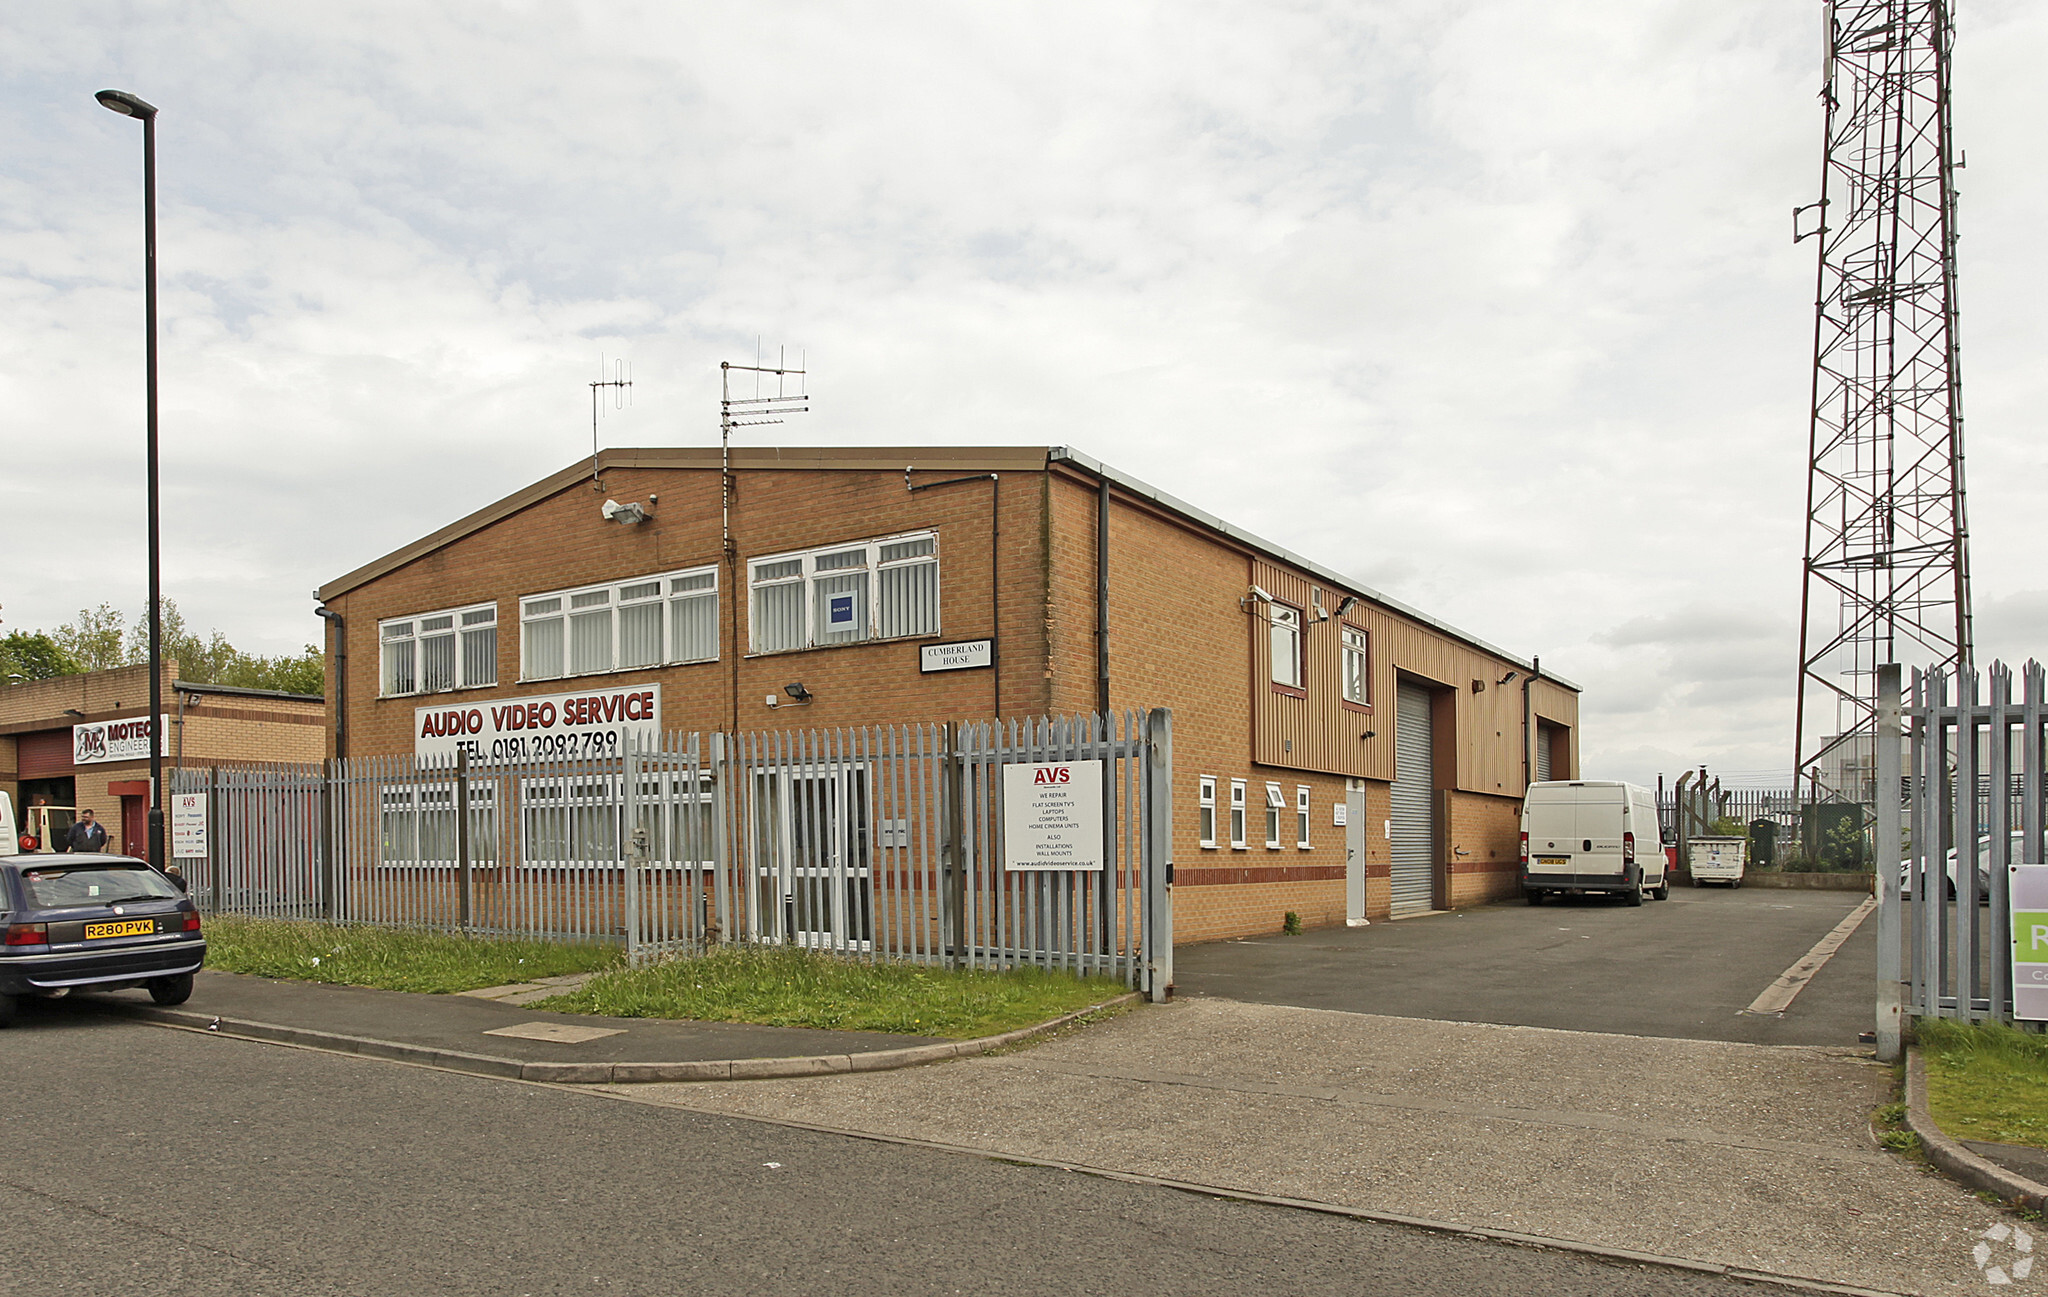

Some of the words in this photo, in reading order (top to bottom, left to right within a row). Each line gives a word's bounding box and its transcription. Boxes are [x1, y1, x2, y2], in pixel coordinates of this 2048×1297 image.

[928, 644, 984, 657] CUMBERLAND
[943, 655, 970, 665] HOUSE
[421, 708, 483, 738] AUDIO
[491, 701, 557, 732] VIDEO
[562, 691, 654, 726] SERVICE
[1034, 767, 1070, 784] AVS
[183, 797, 196, 807] AVS
[87, 924, 123, 937] R280
[126, 921, 152, 933] PVK
